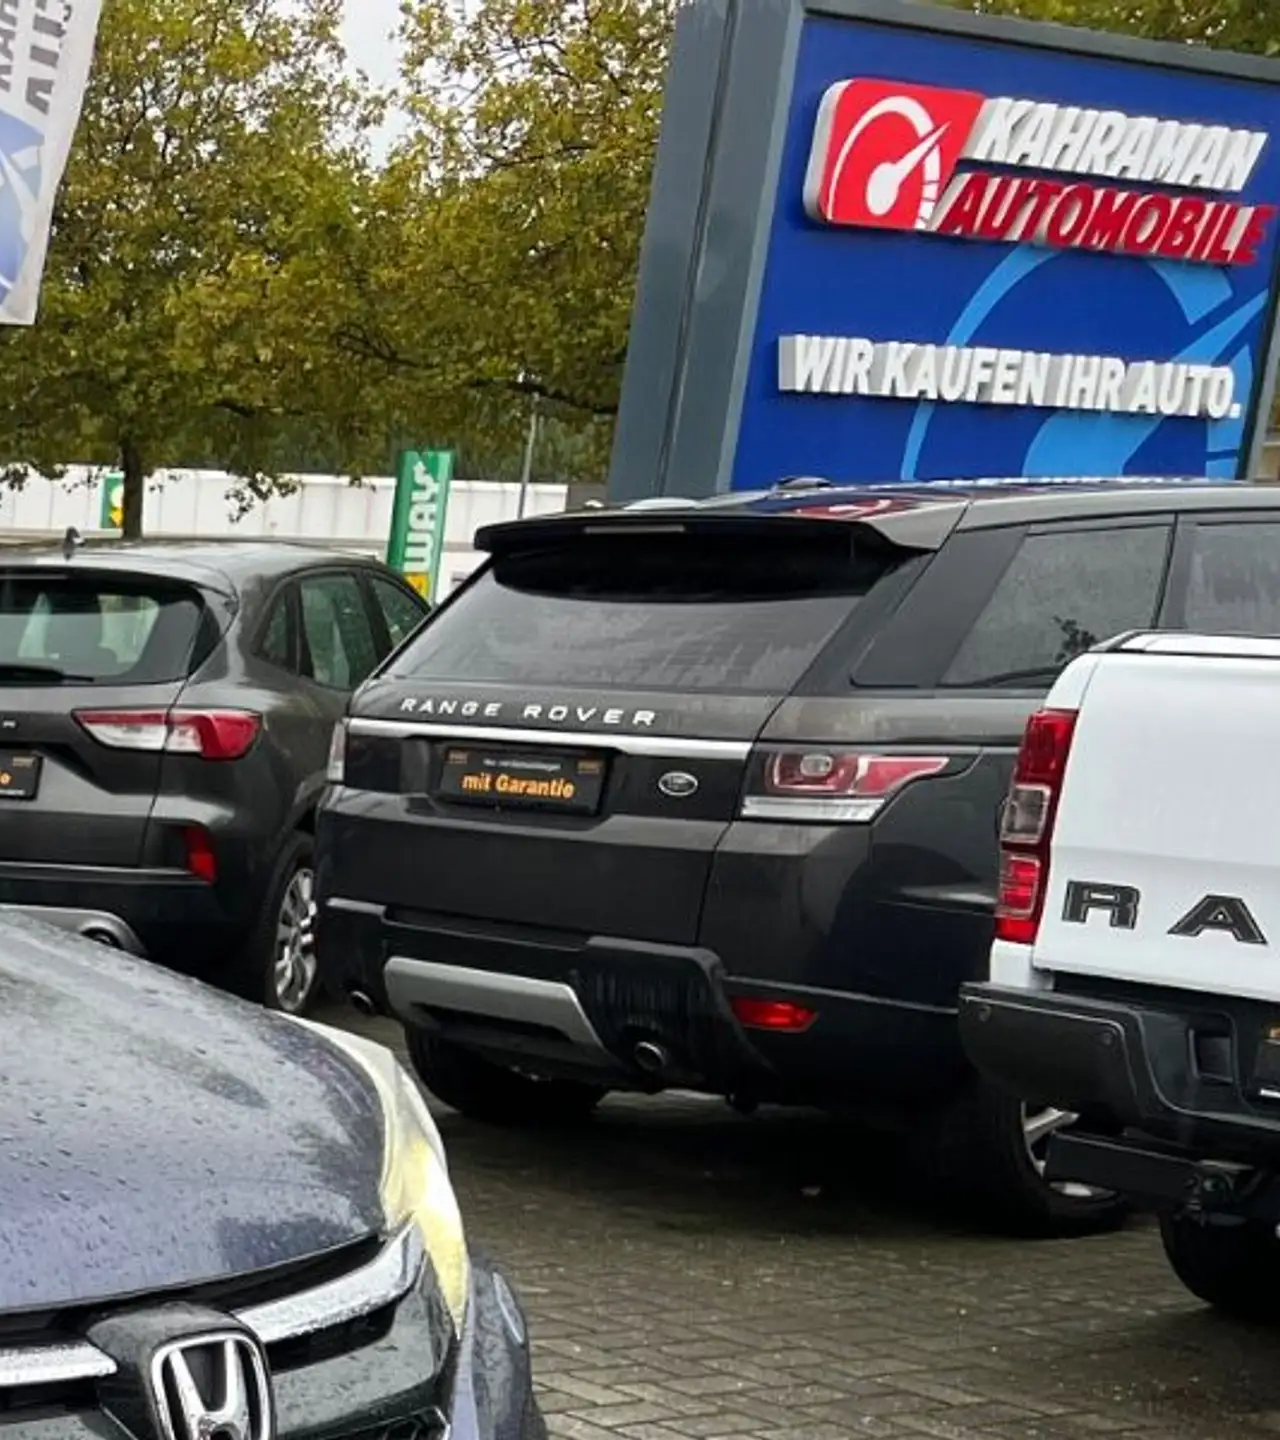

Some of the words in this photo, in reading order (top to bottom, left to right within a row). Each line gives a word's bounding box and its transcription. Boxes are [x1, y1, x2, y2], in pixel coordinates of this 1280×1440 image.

[967, 97, 1269, 191] KAHRAMAN
[937, 169, 1279, 266] AUTOMOBILE
[786, 334, 874, 394] WIR
[880, 341, 1052, 405] KAUFEN
[1056, 353, 1127, 411] IHR
[1133, 359, 1241, 419] AUTO.
[401, 697, 503, 718] RANGE
[523, 704, 657, 727] ROVER
[461, 772, 490, 792] mit
[495, 773, 576, 799] Garantie
[1061, 879, 1268, 945] RA
